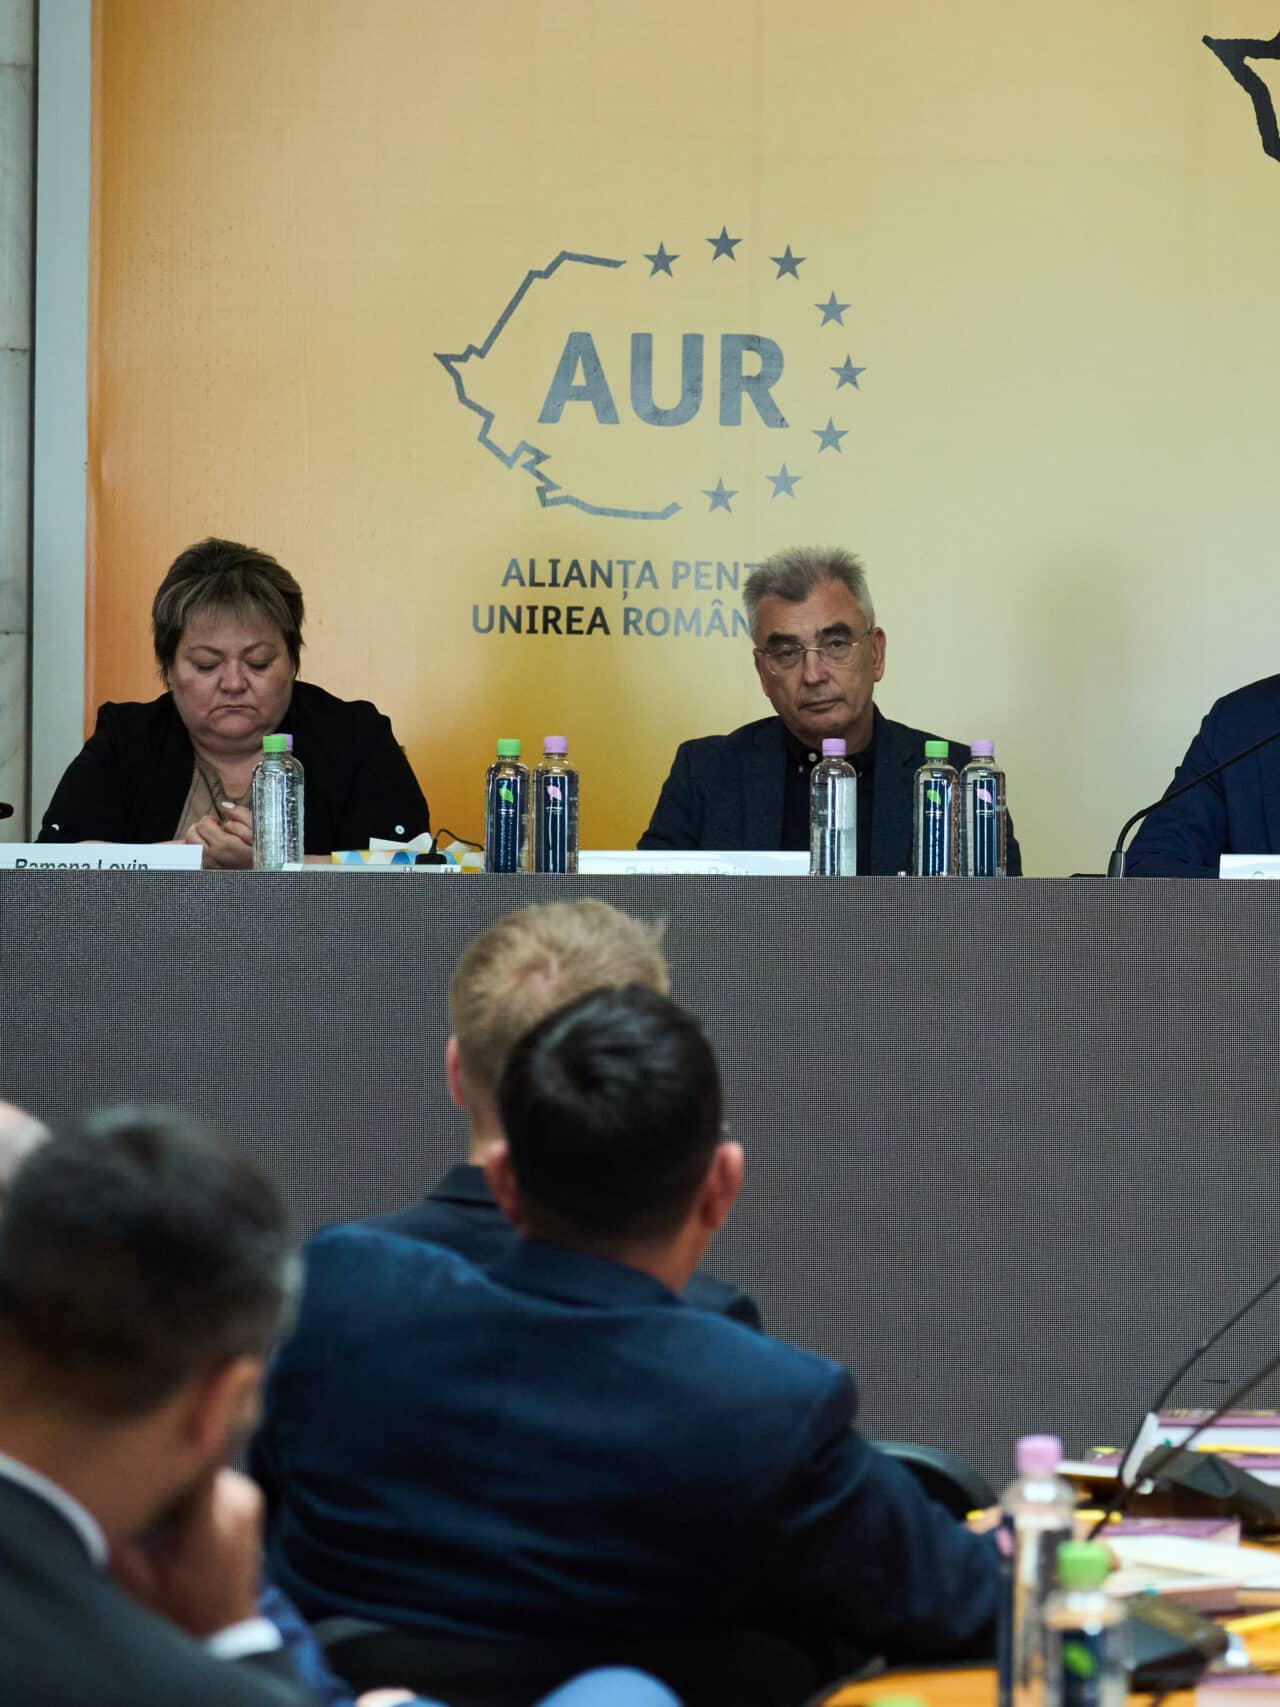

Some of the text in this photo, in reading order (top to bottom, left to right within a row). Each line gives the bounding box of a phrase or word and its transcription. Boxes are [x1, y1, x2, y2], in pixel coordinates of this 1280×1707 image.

[537, 331, 790, 429] AUR
[501, 558, 660, 600] ALIANȚA
[471, 599, 752, 638] UNIREA ROMÂN
